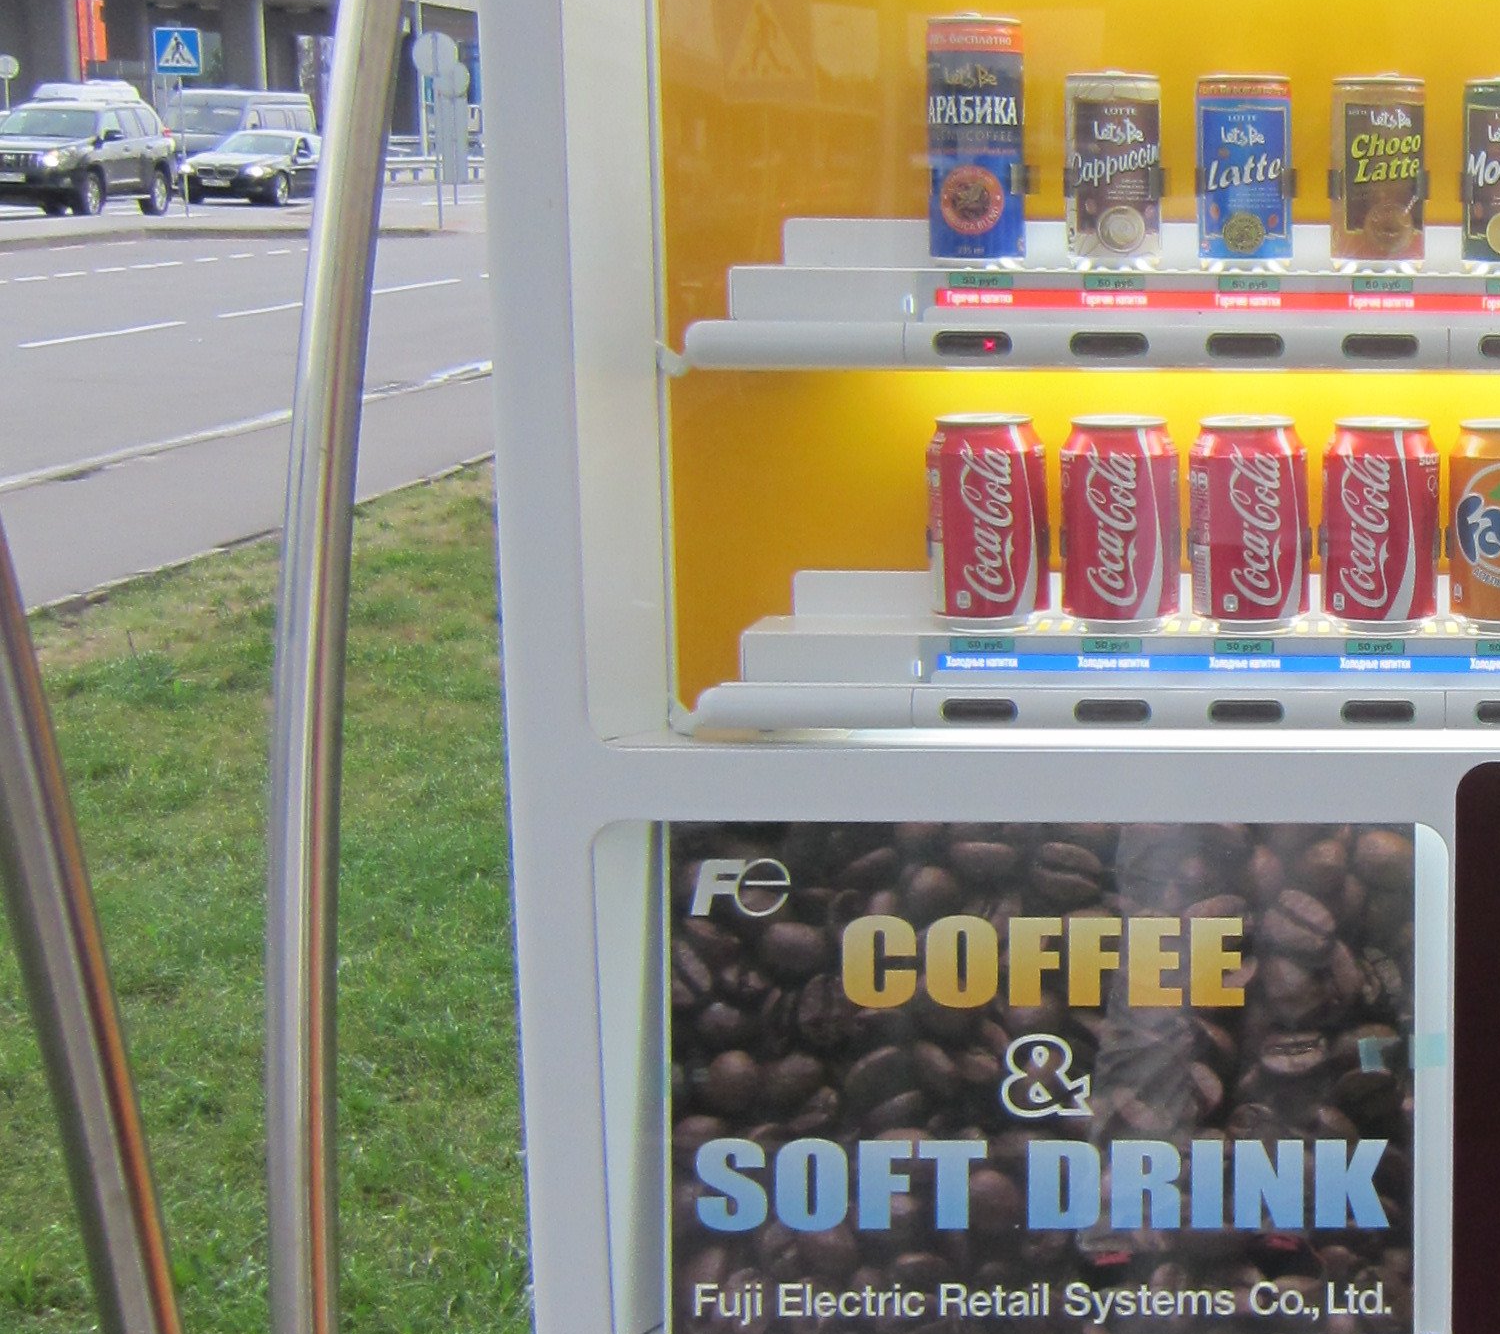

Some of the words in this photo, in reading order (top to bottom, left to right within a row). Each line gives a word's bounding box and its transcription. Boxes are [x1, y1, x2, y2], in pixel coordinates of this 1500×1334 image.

[928, 95, 1018, 126] АРАБИКА
[1351, 133, 1421, 160] Choco
[1208, 153, 1282, 190] Latte
[1354, 157, 1420, 184] Latte
[984, 641, 1003, 650] руб
[1112, 642, 1130, 650] руб
[1243, 642, 1261, 653] руб
[1374, 643, 1392, 653] руб
[842, 914, 1245, 1008] COFFEE
[1000, 1033, 1093, 1118] &
[693, 1138, 988, 1233] SOFT
[1027, 1138, 1390, 1231] DRINK
[693, 1282, 763, 1324] Fuji
[778, 1282, 925, 1319] Electric
[939, 1281, 1050, 1318] Retail
[1064, 1280, 1235, 1325] Systems
